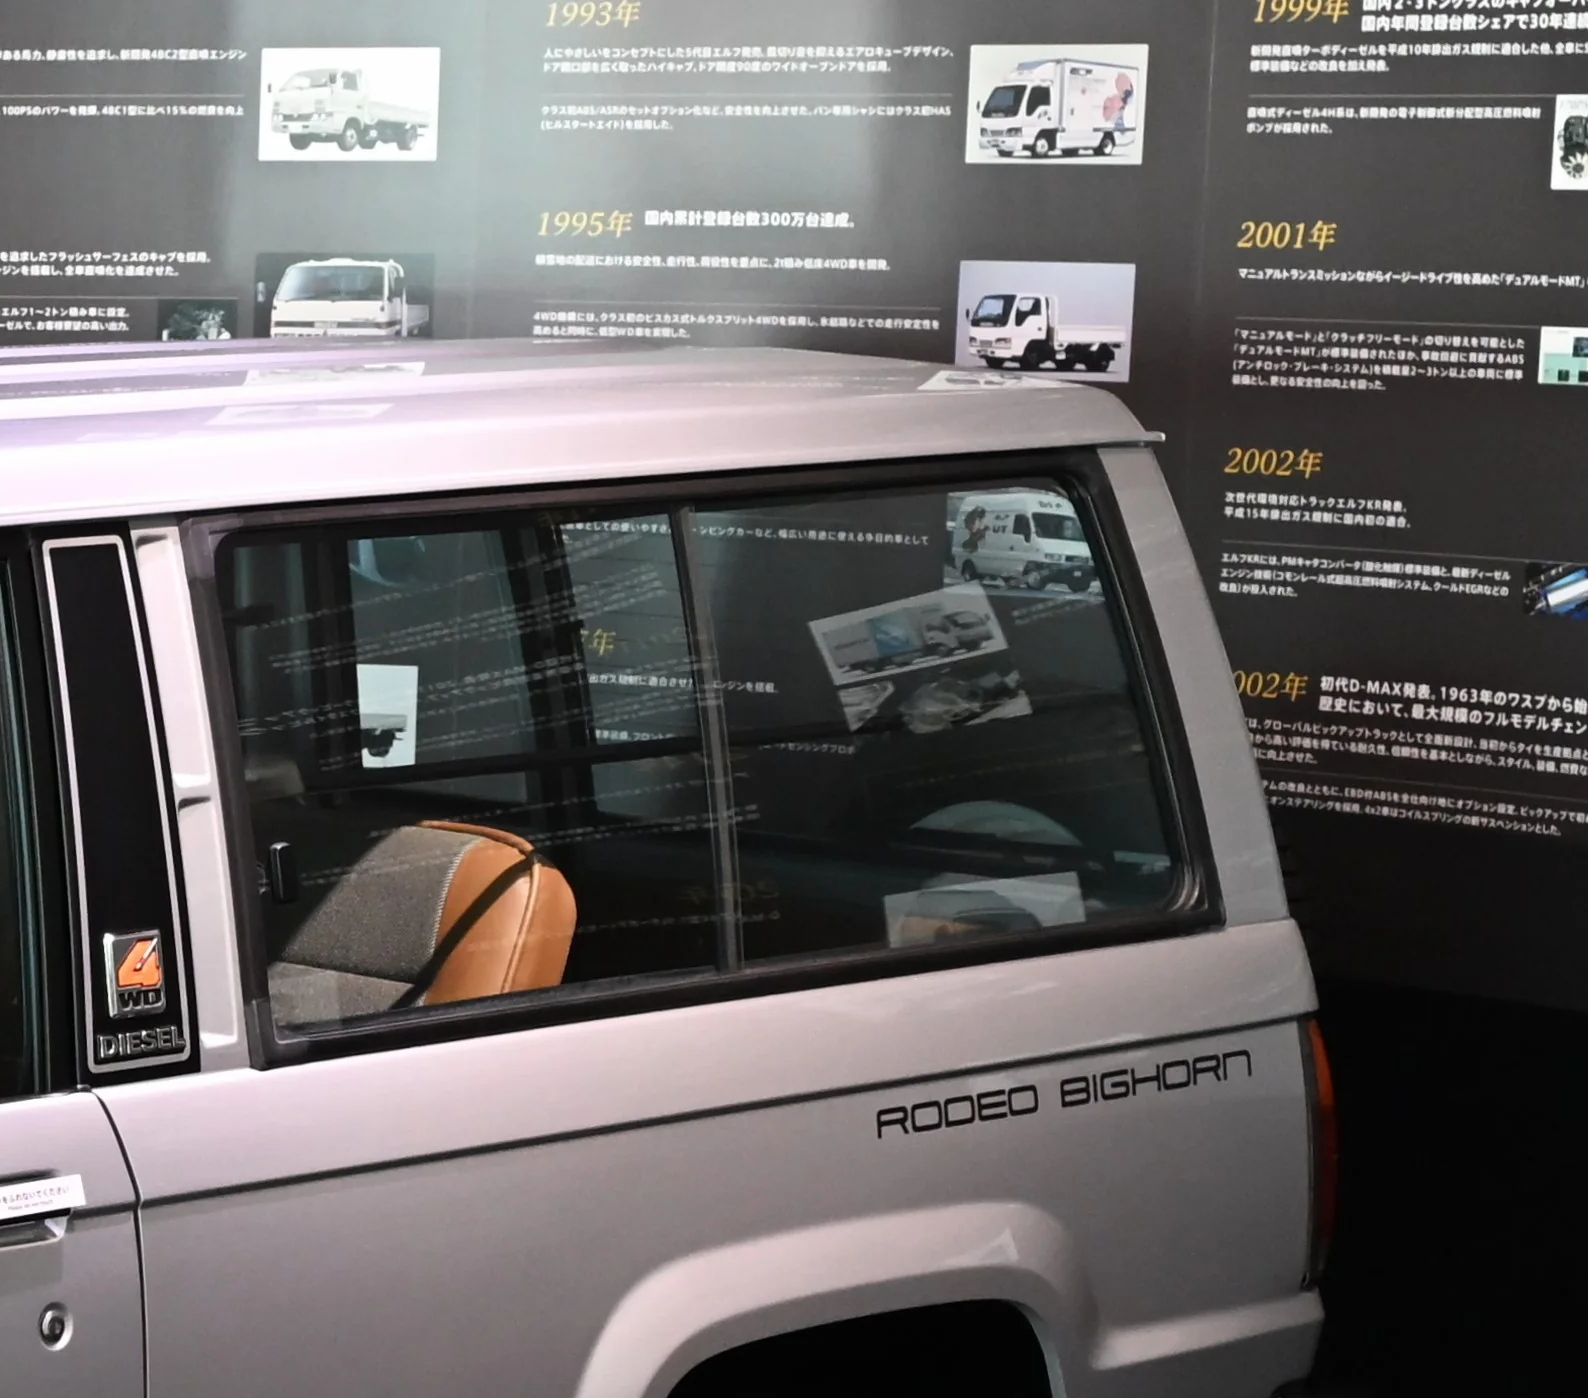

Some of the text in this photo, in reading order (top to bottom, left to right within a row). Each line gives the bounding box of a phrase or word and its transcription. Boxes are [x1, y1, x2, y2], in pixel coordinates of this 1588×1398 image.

[546, 0, 641, 28] 1993年
[1253, 0, 1349, 24] 1999年
[537, 210, 634, 238] 1995年
[1236, 220, 1338, 251] 2001年
[1223, 447, 1323, 479] 2002年
[98, 1025, 186, 1060] DIESEL
[877, 1050, 1252, 1139] RODEO BIGHORN
